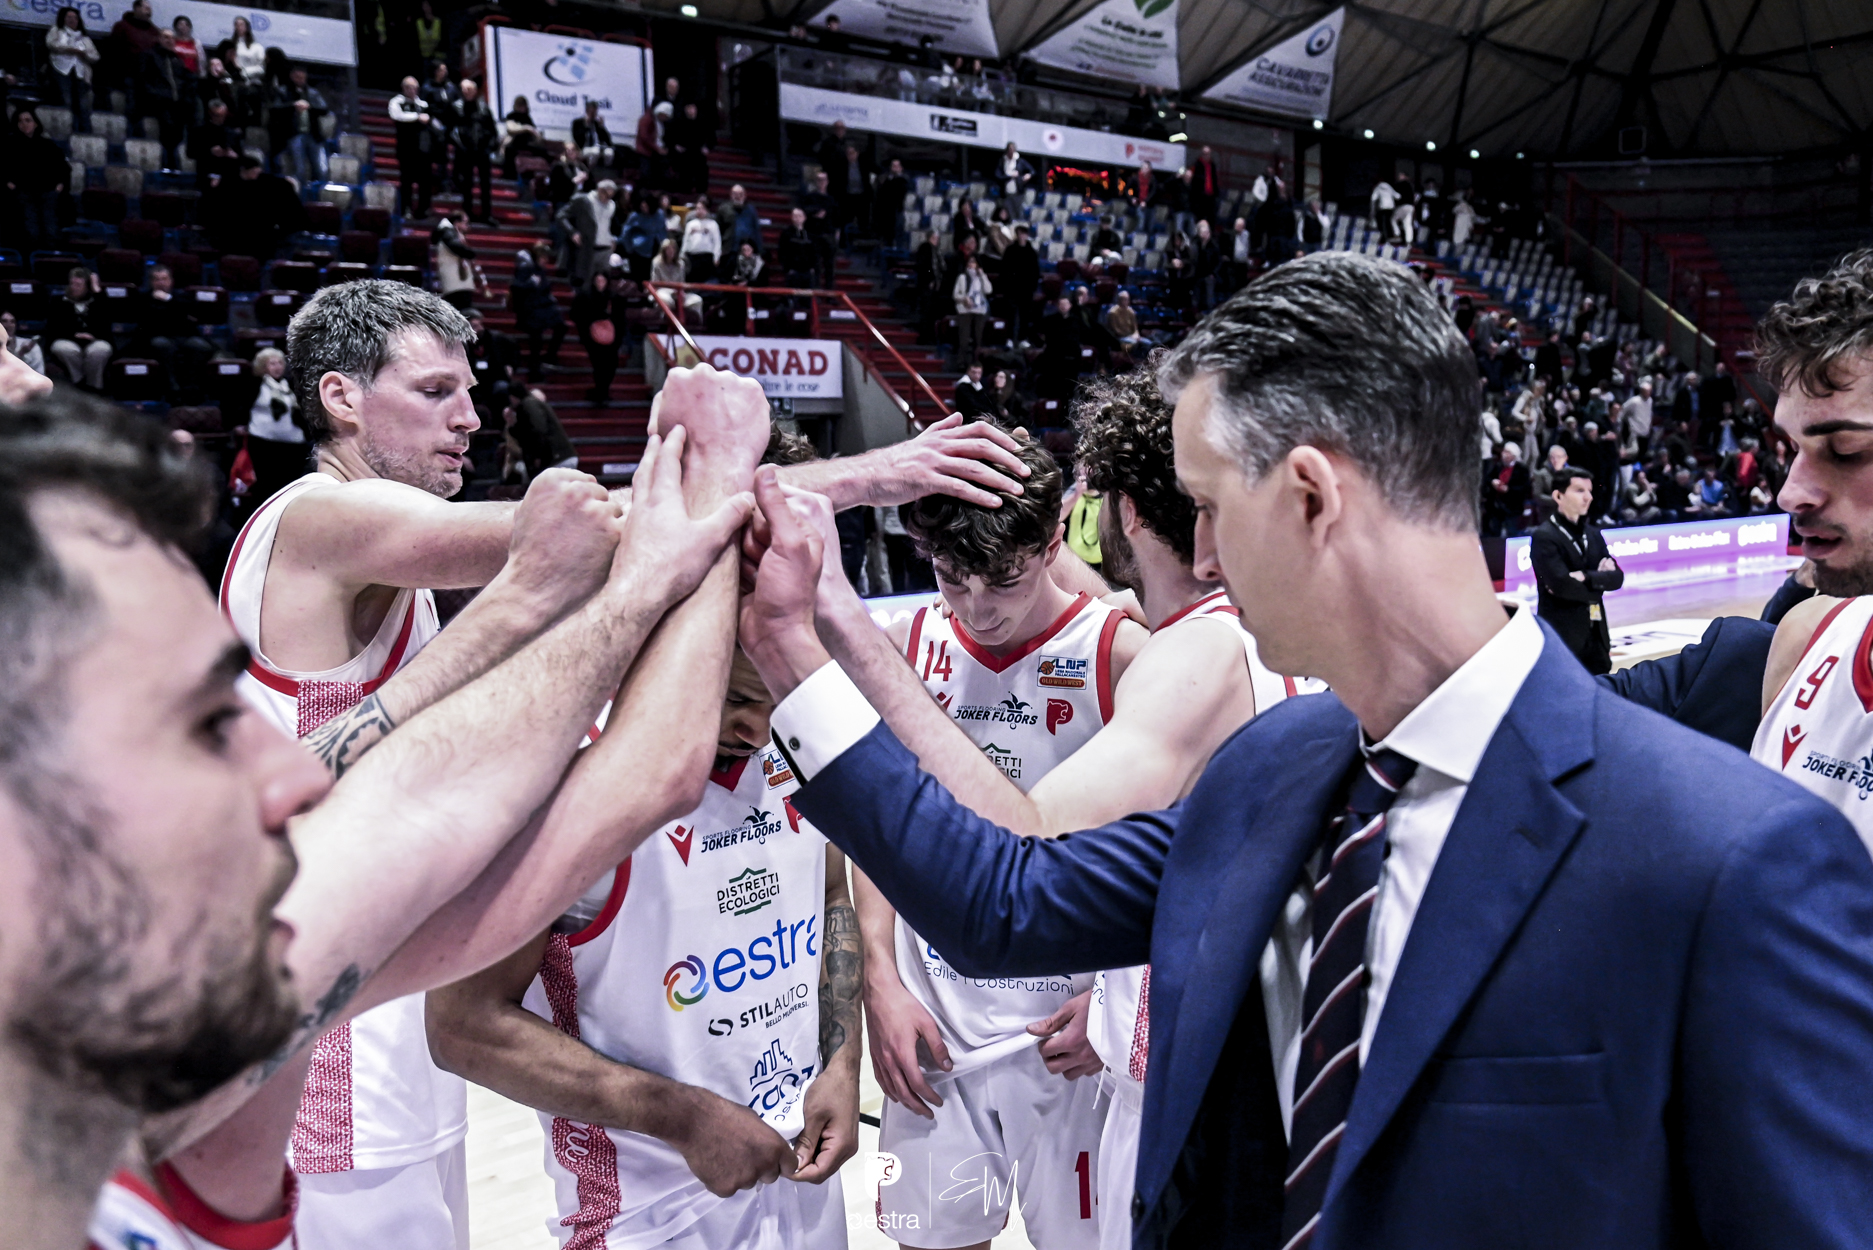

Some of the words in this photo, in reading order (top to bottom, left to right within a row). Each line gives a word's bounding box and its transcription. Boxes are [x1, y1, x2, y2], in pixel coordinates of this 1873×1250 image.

[708, 347, 829, 376] CONAD
[923, 640, 952, 681] 14
[1055, 658, 1087, 670] LNP
[1794, 655, 1840, 710] 9
[954, 709, 990, 721] JOKER
[991, 711, 1039, 726] FLOORS
[979, 705, 1006, 713] FLOORING
[1802, 755, 1847, 781] JOKER
[701, 833, 738, 853] JOKER
[740, 820, 782, 843] FLOORS
[702, 831, 723, 841] SPORTS
[724, 824, 752, 837] FLOORING
[717, 872, 779, 902] DISTRETTI
[719, 884, 780, 914] ECOLOGICI
[924, 961, 957, 981] Edile
[973, 977, 1074, 995] Costruzioni
[740, 983, 808, 1028] STILAUTO
[765, 1014, 782, 1029] BELLO
[1075, 1151, 1099, 1220] 1
